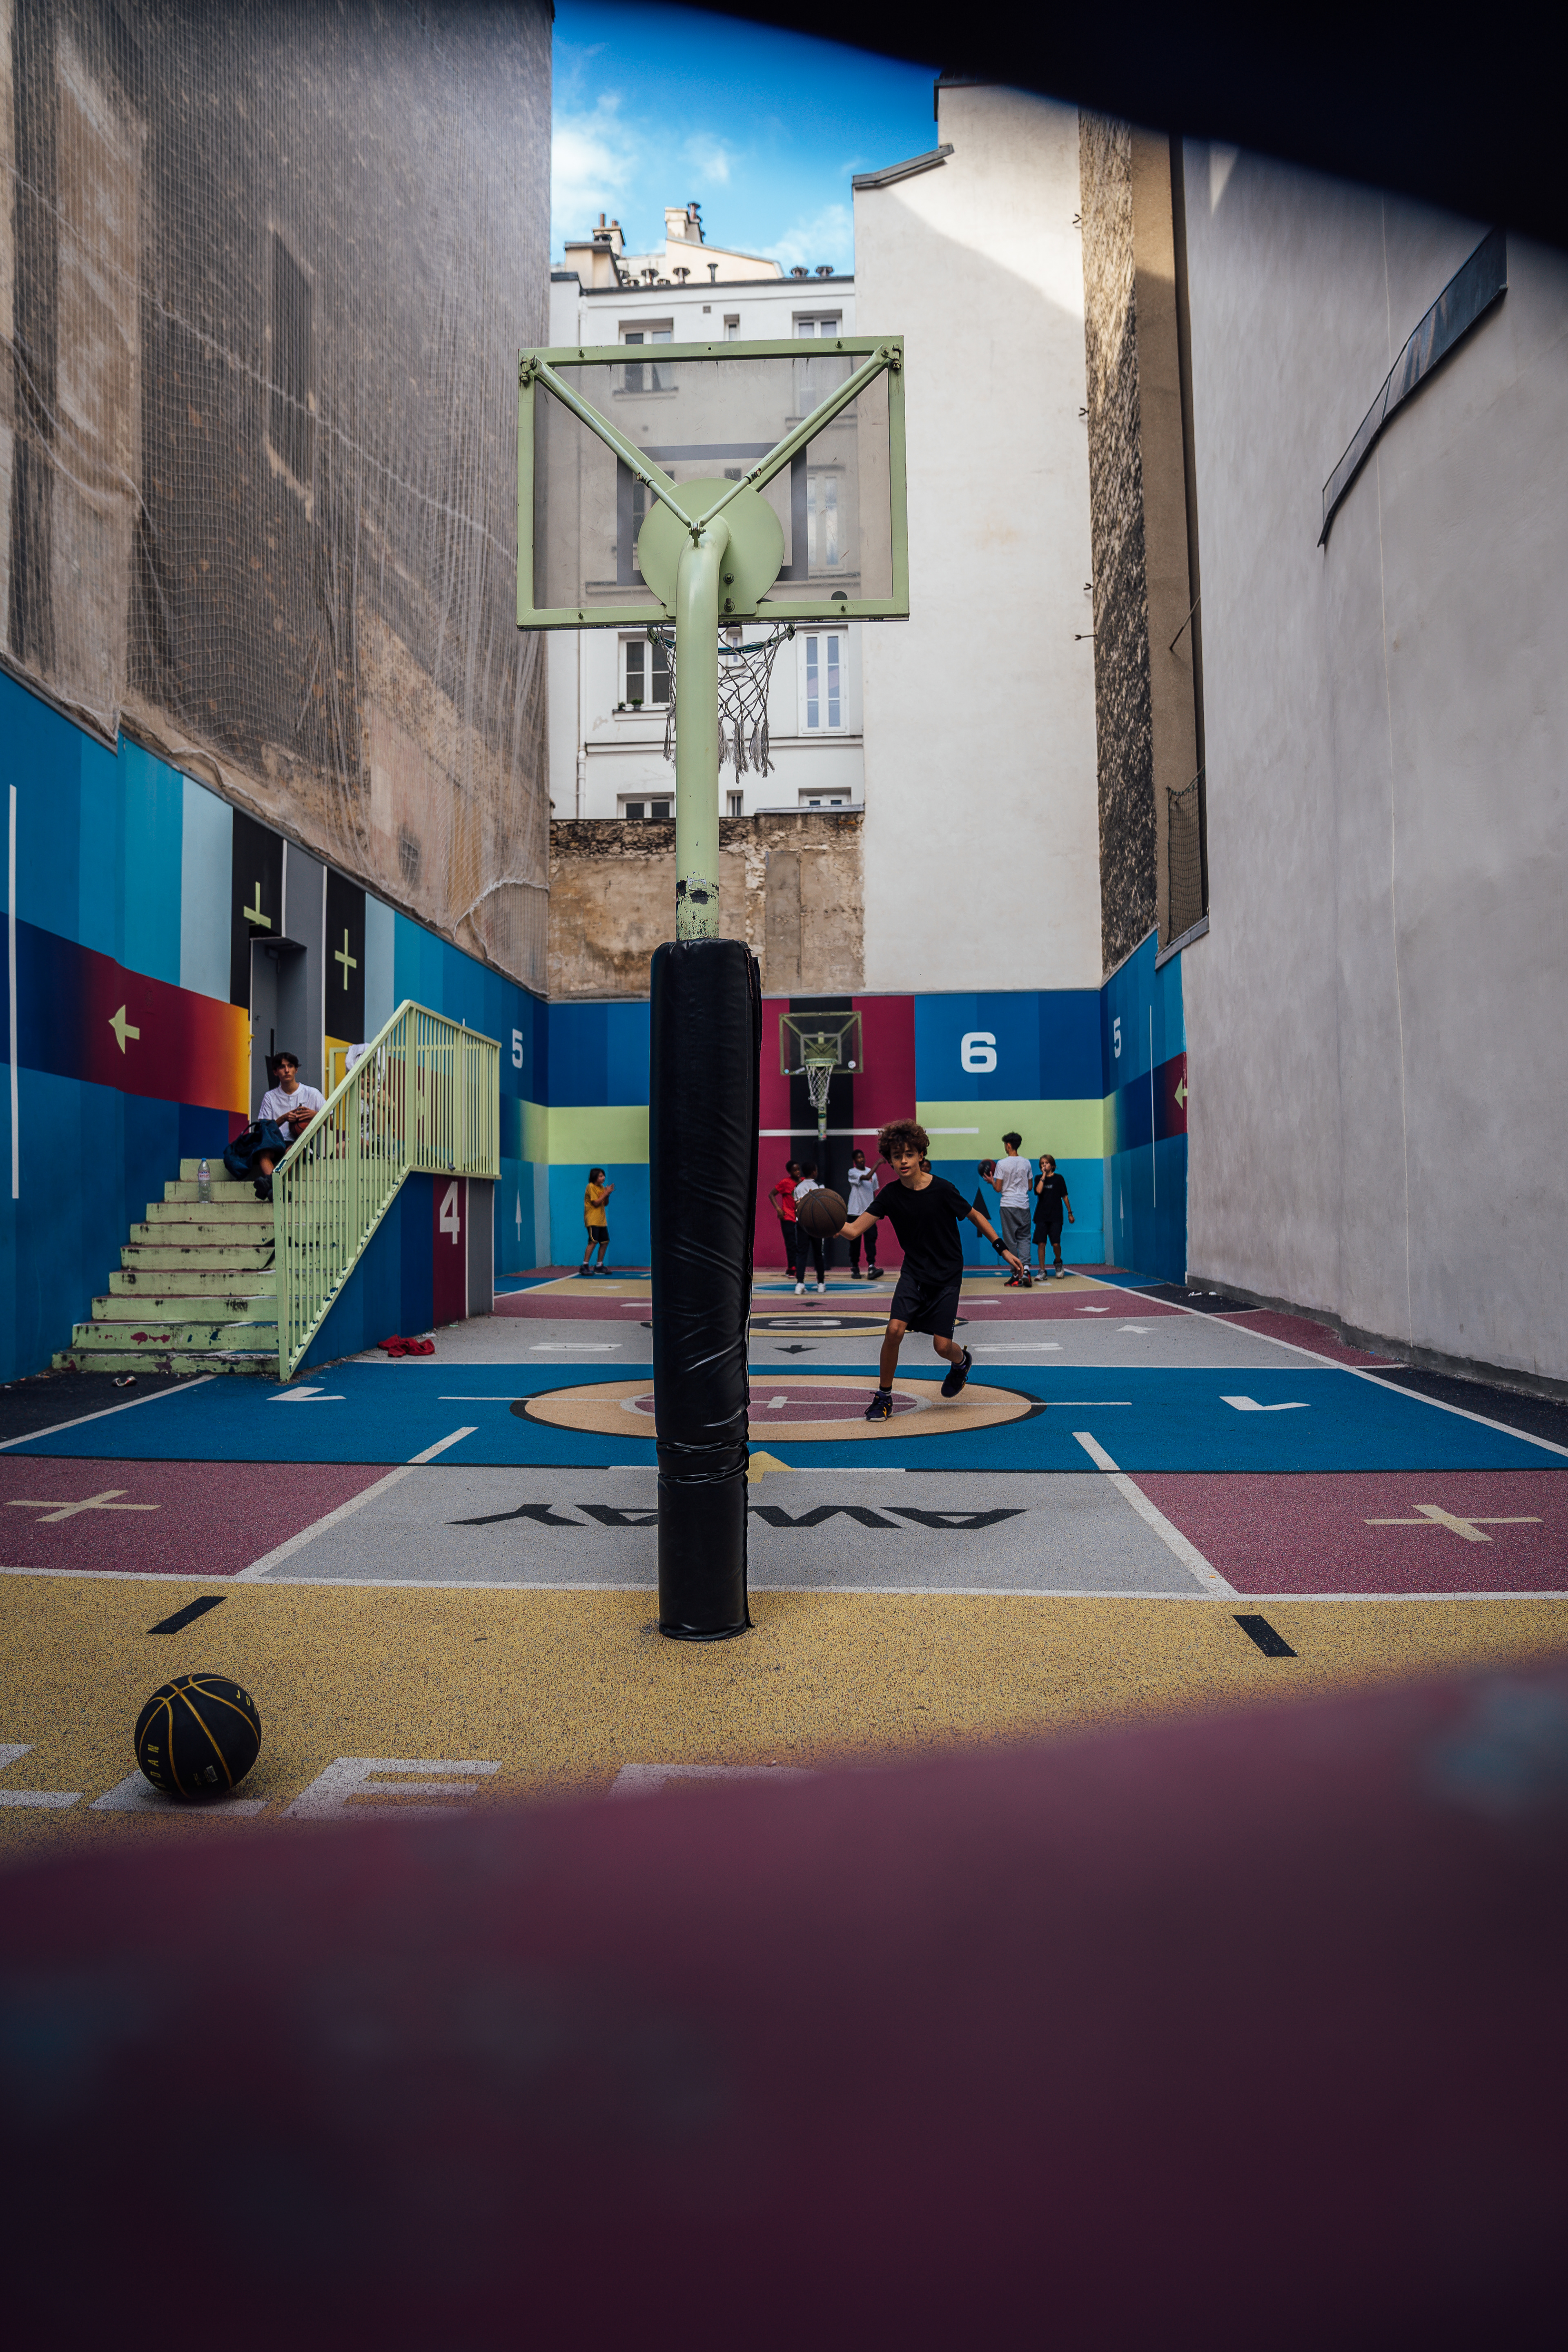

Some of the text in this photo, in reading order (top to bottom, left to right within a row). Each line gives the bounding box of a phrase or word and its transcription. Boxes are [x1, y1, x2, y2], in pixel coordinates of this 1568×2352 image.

[512, 1028, 523, 1069] 5
[961, 1031, 998, 1073] 6
[1114, 1017, 1121, 1058] 5
[439, 1181, 460, 1245] 4
